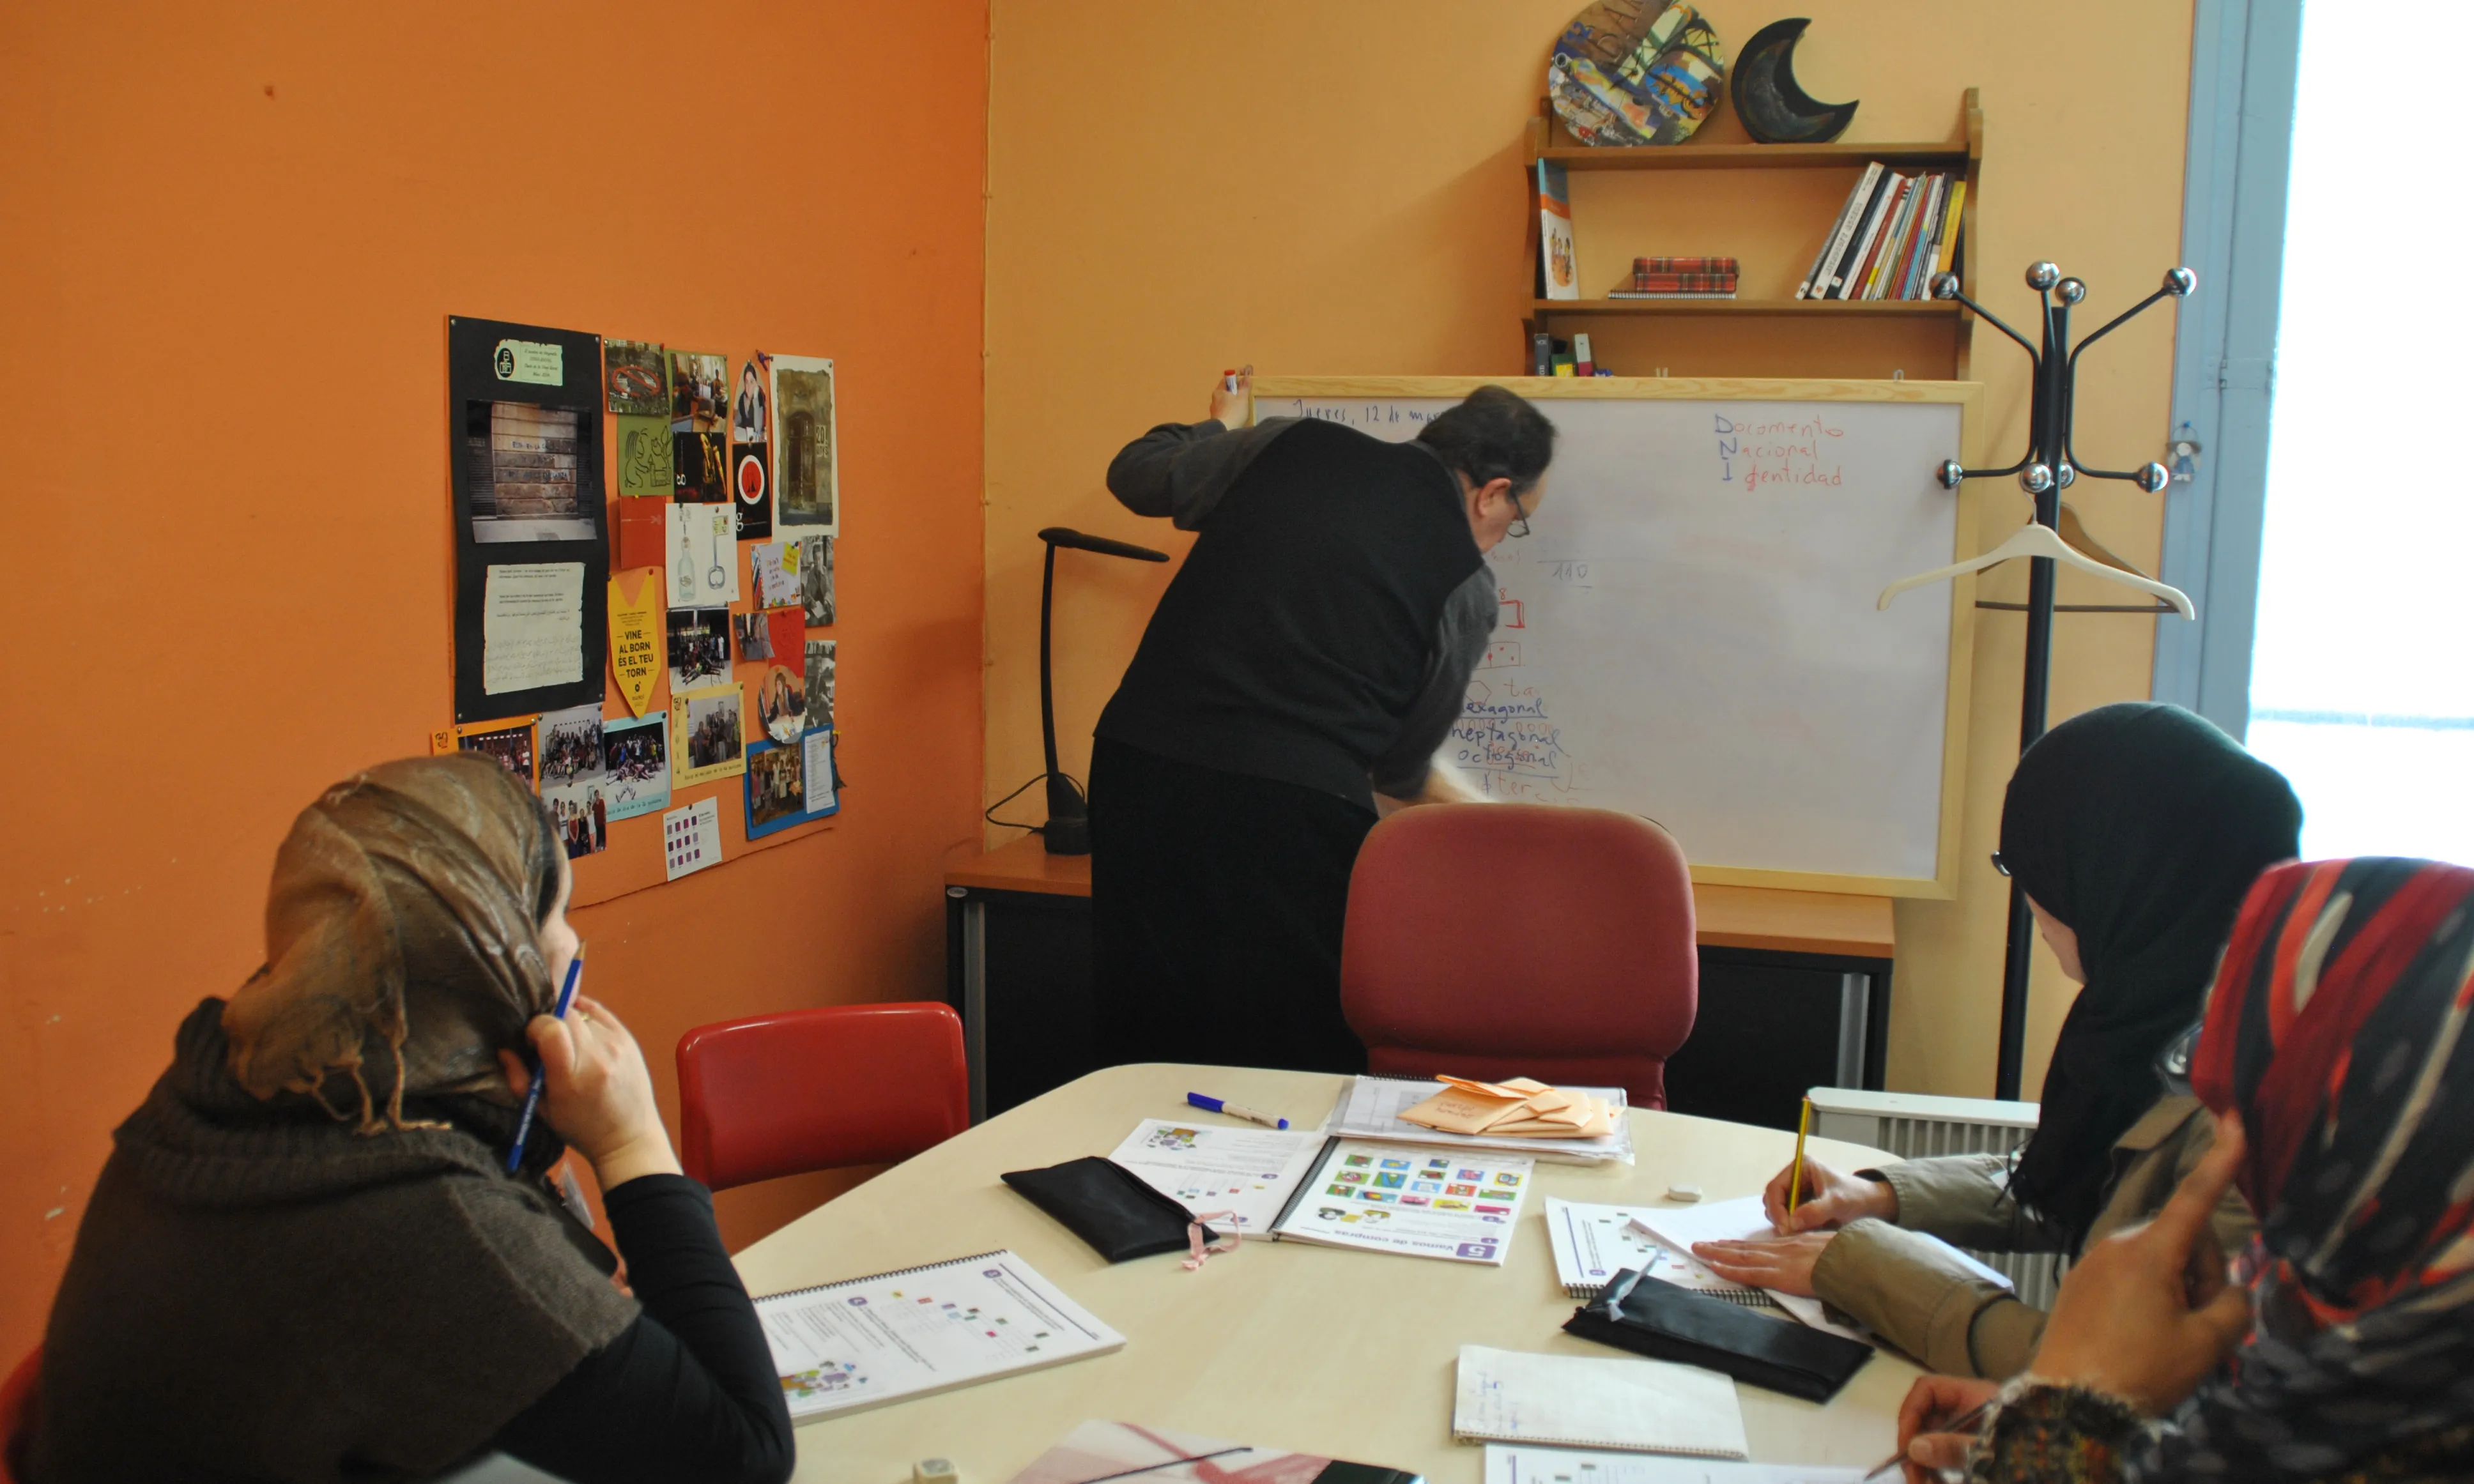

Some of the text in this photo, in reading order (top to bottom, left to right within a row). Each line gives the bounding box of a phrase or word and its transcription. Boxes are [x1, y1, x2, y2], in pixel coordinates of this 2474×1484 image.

[1365, 406, 1380, 422] 12
[1388, 405, 1400, 424] de
[624, 630, 642, 640] VINE
[619, 641, 650, 654] AL BORN
[618, 654, 654, 667] ÉS EL TEU
[626, 667, 647, 678] TORN
[1462, 698, 1548, 724] exagonal
[1333, 1228, 1390, 1243] compras
[1392, 1237, 1408, 1246] de
[1411, 1240, 1455, 1251] Vamos
[1467, 1244, 1486, 1257] 5
